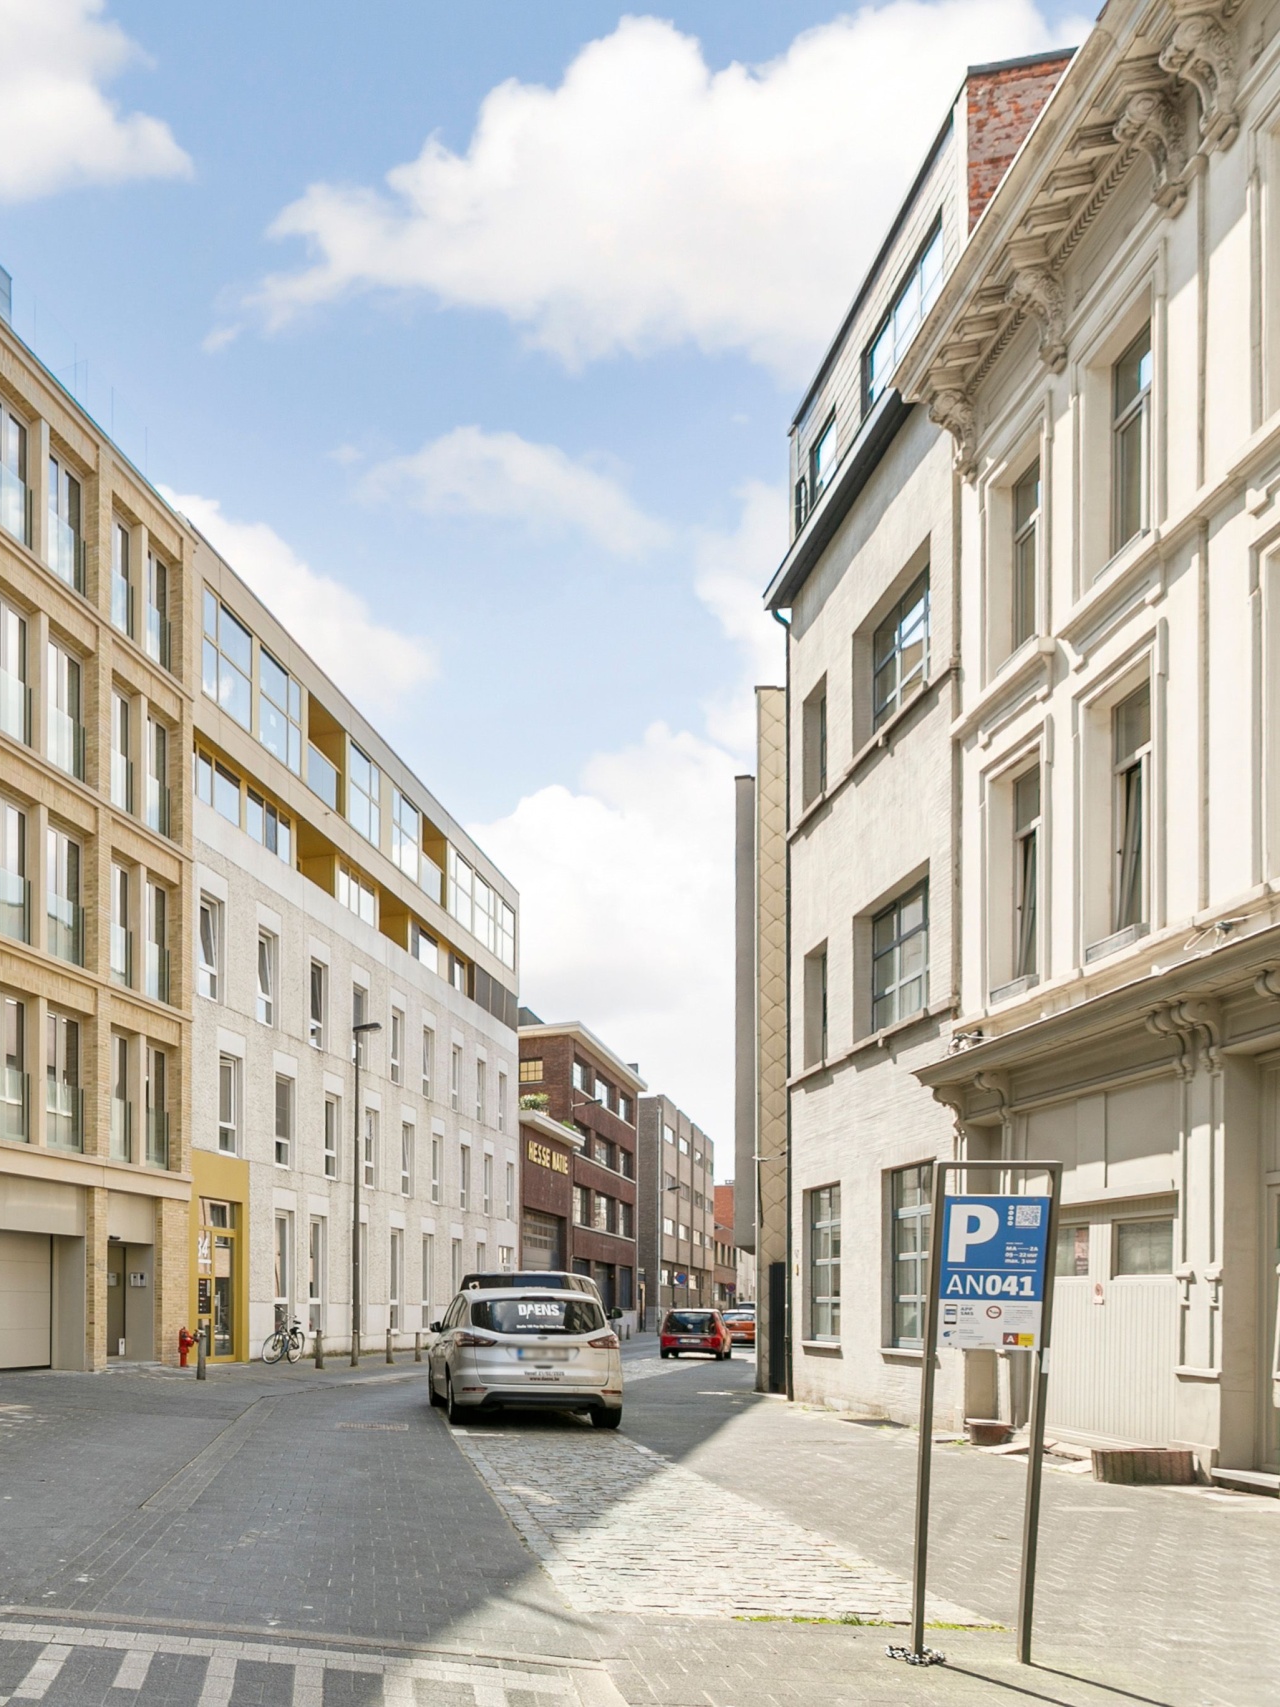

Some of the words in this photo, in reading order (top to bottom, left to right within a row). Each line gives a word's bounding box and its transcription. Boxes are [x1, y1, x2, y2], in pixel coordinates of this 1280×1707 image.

[528, 1140, 550, 1168] HESSE
[947, 1204, 999, 1263] P
[946, 1274, 1035, 1296] AN041
[518, 1304, 560, 1319] DAENS
